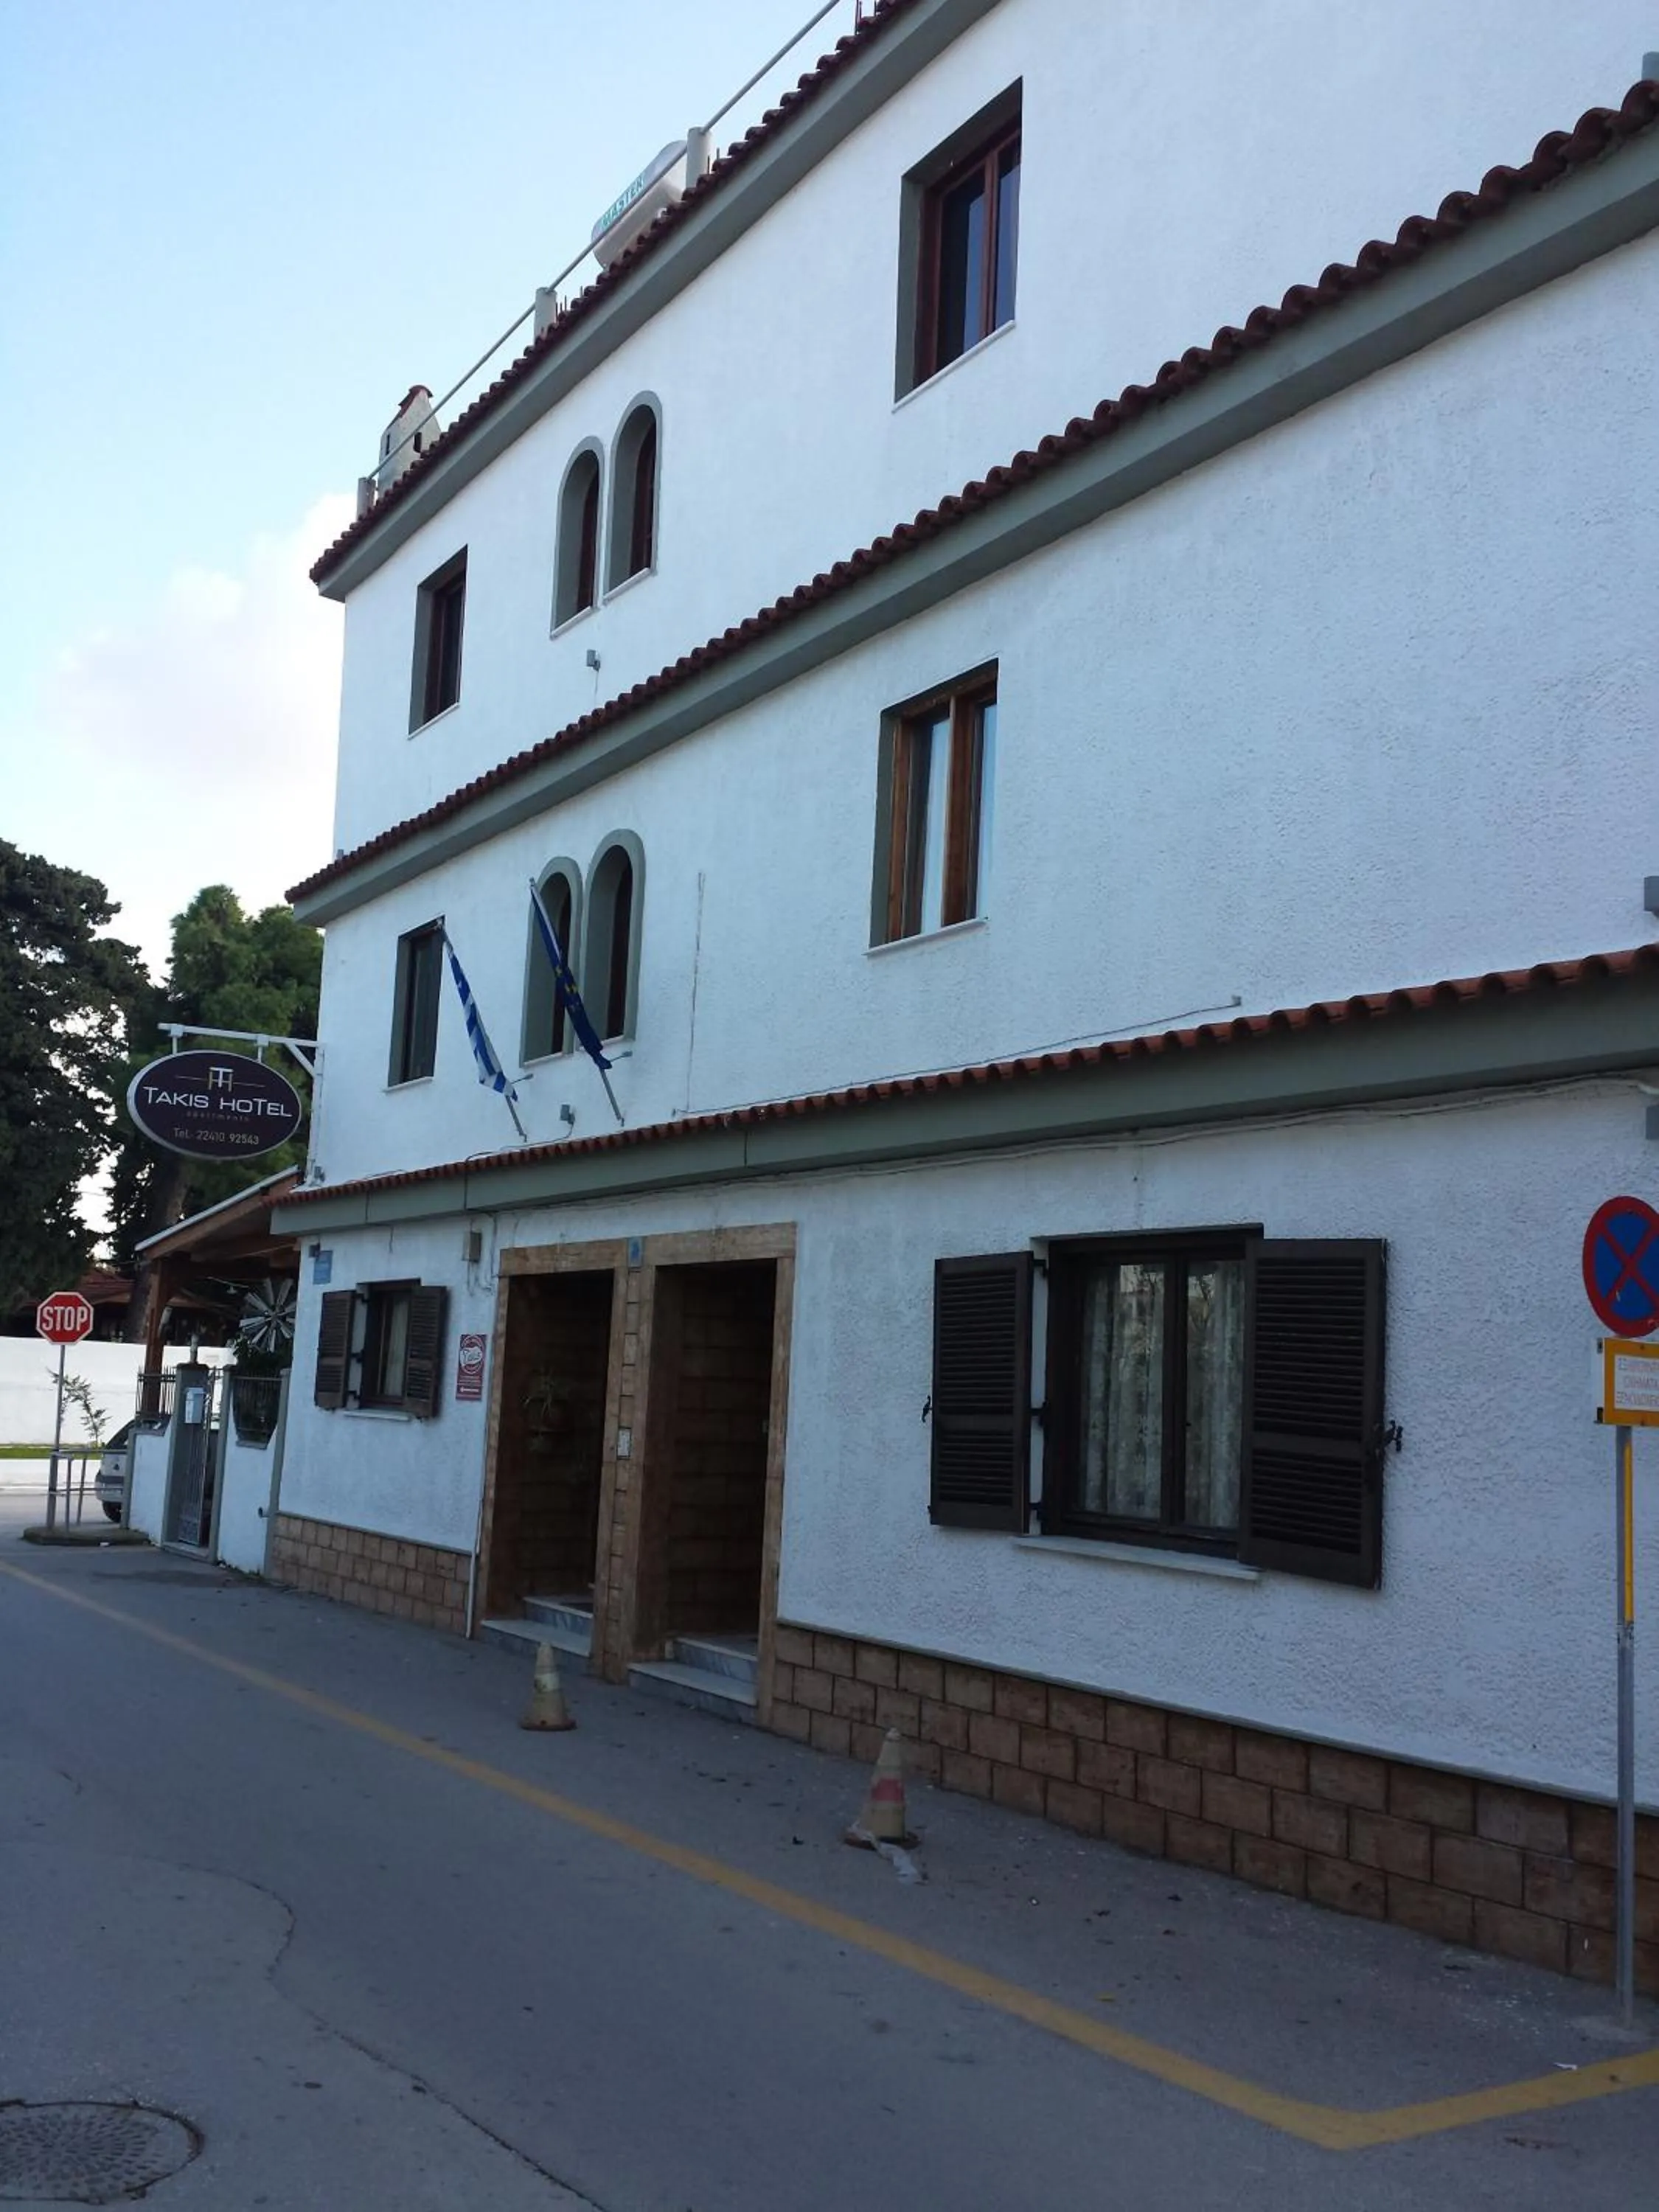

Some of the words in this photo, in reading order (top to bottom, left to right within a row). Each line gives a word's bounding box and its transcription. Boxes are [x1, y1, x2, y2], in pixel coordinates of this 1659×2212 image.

[143, 1086, 209, 1108] TAKIS
[220, 1098, 293, 1117] HOTEL
[42, 1306, 88, 1331] STOP
